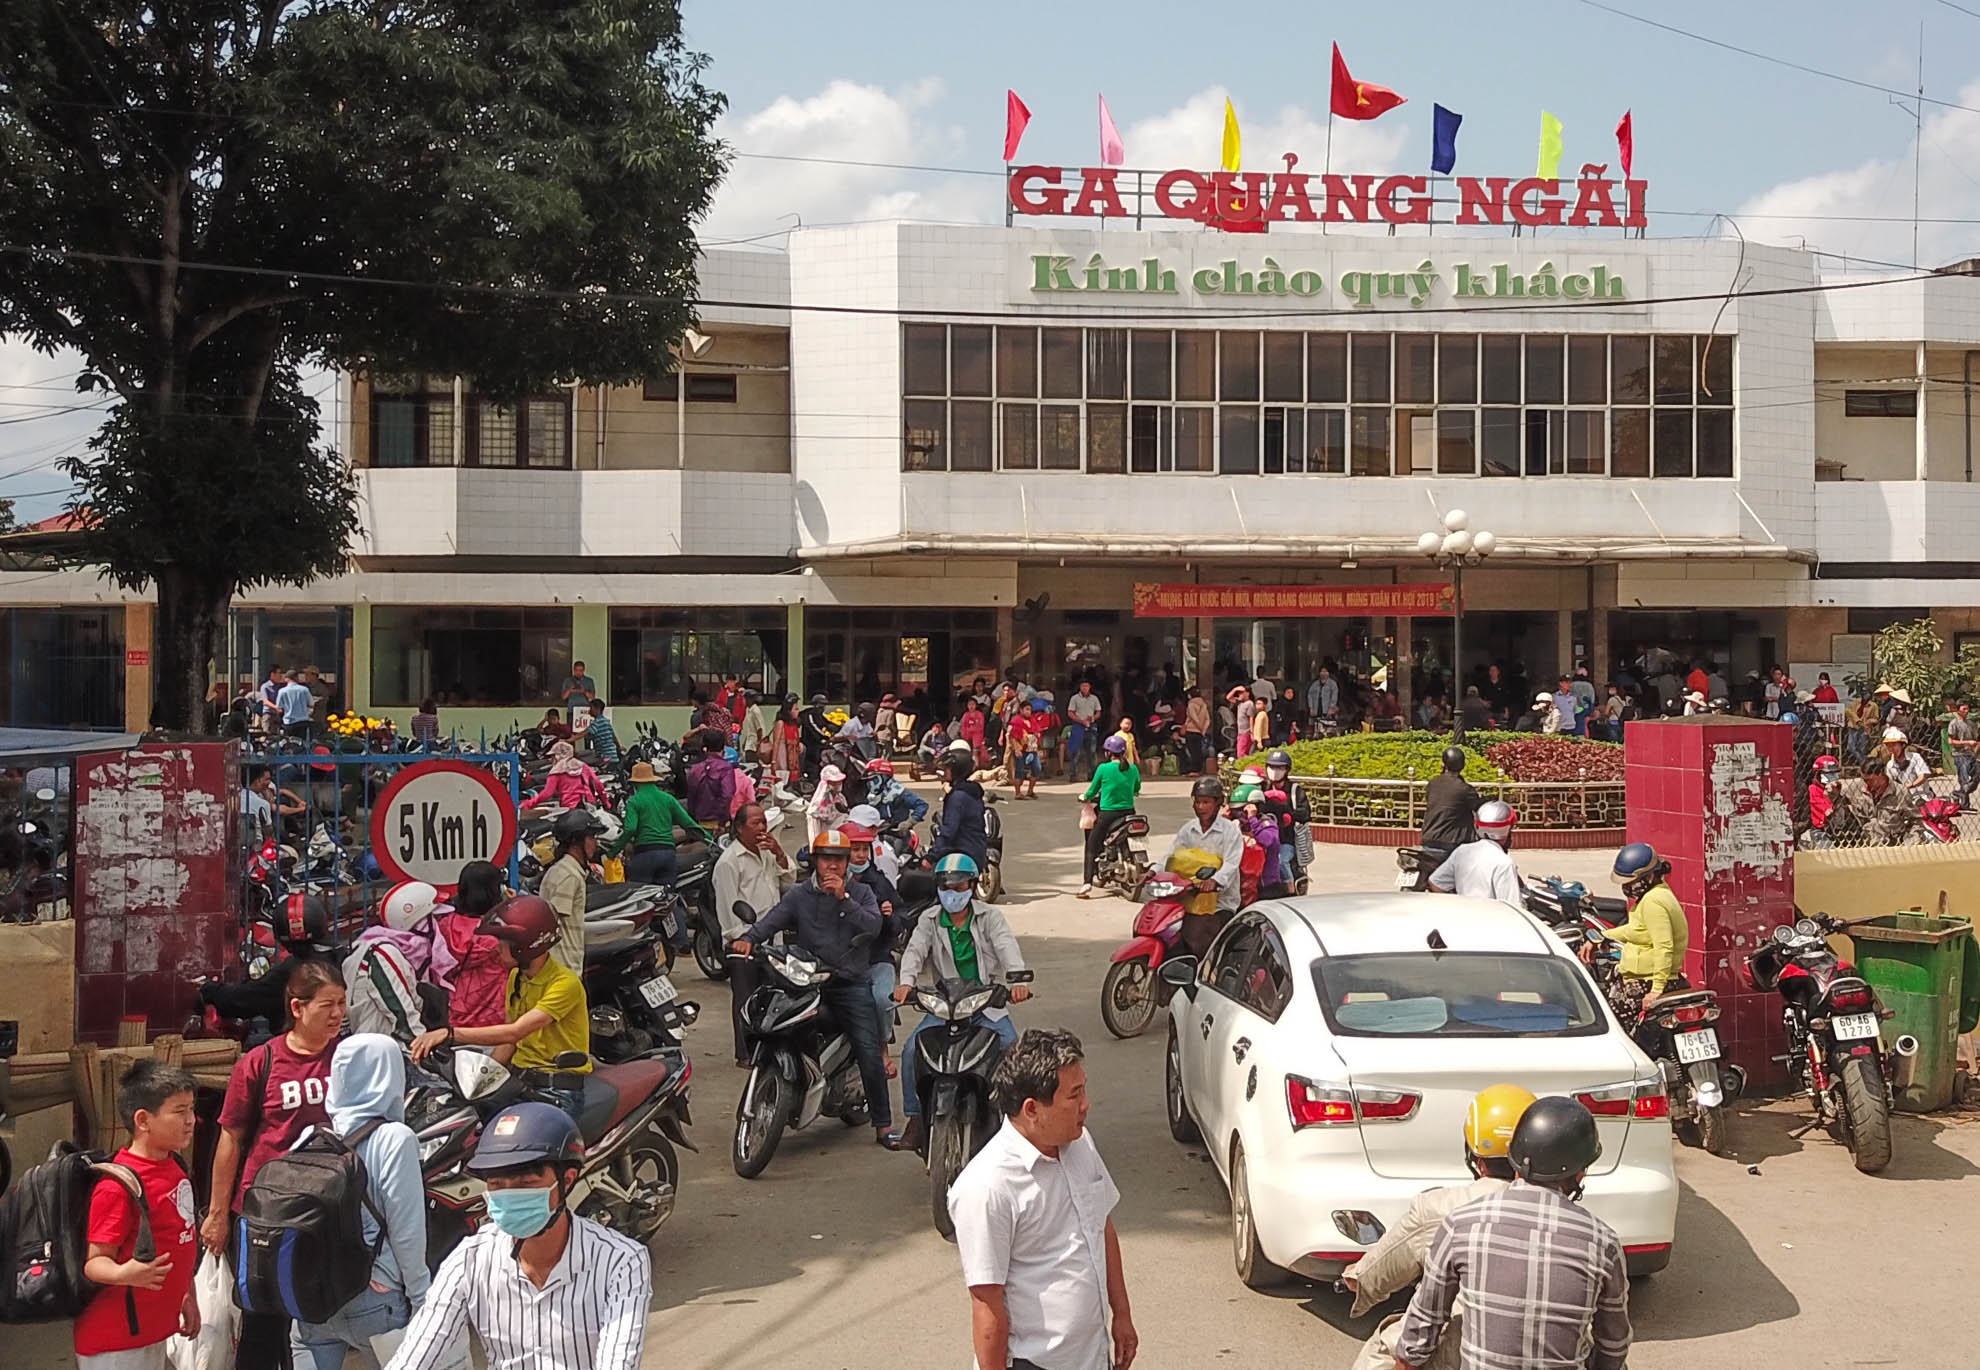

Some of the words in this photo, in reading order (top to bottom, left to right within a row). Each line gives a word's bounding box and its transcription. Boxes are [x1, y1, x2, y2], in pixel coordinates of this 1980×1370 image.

[1008, 165, 1128, 217] GA
[1155, 152, 1434, 225] QUẢNG
[1456, 163, 1648, 228] NGÃI
[1030, 253, 1179, 295] Kính
[1192, 256, 1323, 297] chào
[1340, 259, 1440, 308] quý
[1453, 260, 1627, 300] khách
[1681, 1031, 1710, 1047] 76-E1
[1842, 1025, 1872, 1038] 1278
[280, 1076, 331, 1110] BO
